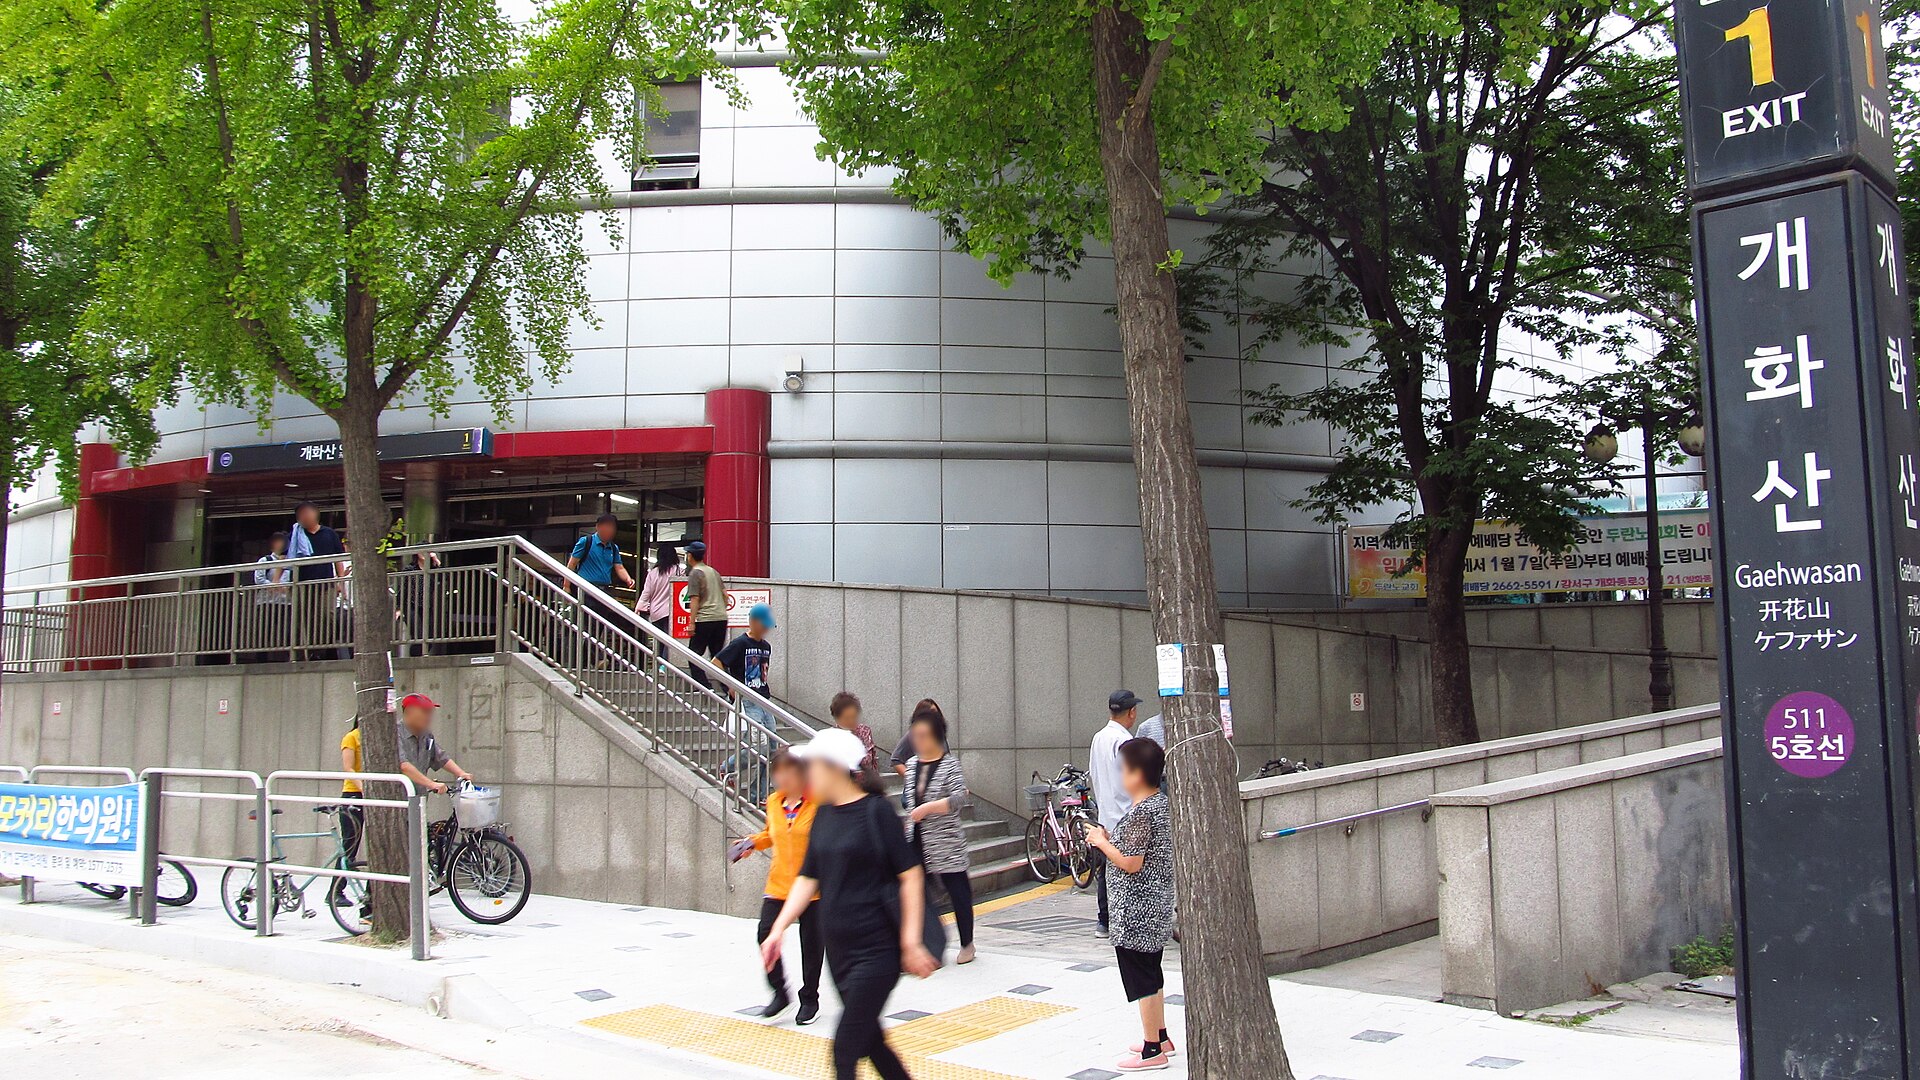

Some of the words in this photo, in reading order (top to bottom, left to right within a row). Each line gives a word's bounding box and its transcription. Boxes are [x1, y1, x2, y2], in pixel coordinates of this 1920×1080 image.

[1724, 6, 1774, 86] 1
[1856, 10, 1875, 89] 1
[1722, 91, 1807, 138] EXIT
[1860, 95, 1885, 138] EXIT
[1737, 216, 1831, 533] 개화산
[1876, 222, 1918, 529] 개화산
[464, 432, 469, 442] 1
[299, 443, 336, 461] 개화산
[1353, 535, 1380, 550] 지역
[1471, 532, 1511, 548] 예배당
[1606, 523, 1694, 544] 두란노회는
[1491, 555, 1515, 572] 1월
[1615, 550, 1648, 567] 예배
[1735, 561, 1862, 588] Gaehwasan
[1492, 580, 1551, 592] 2662-5591
[1561, 578, 1593, 589] 강서구
[1595, 576, 1649, 589] 개화동로3
[1666, 574, 1681, 585] 21
[1758, 596, 1831, 622] 开花山
[1754, 628, 1858, 652] ケファサン
[1783, 708, 1827, 729] 511
[1771, 734, 1846, 761] 5호선
